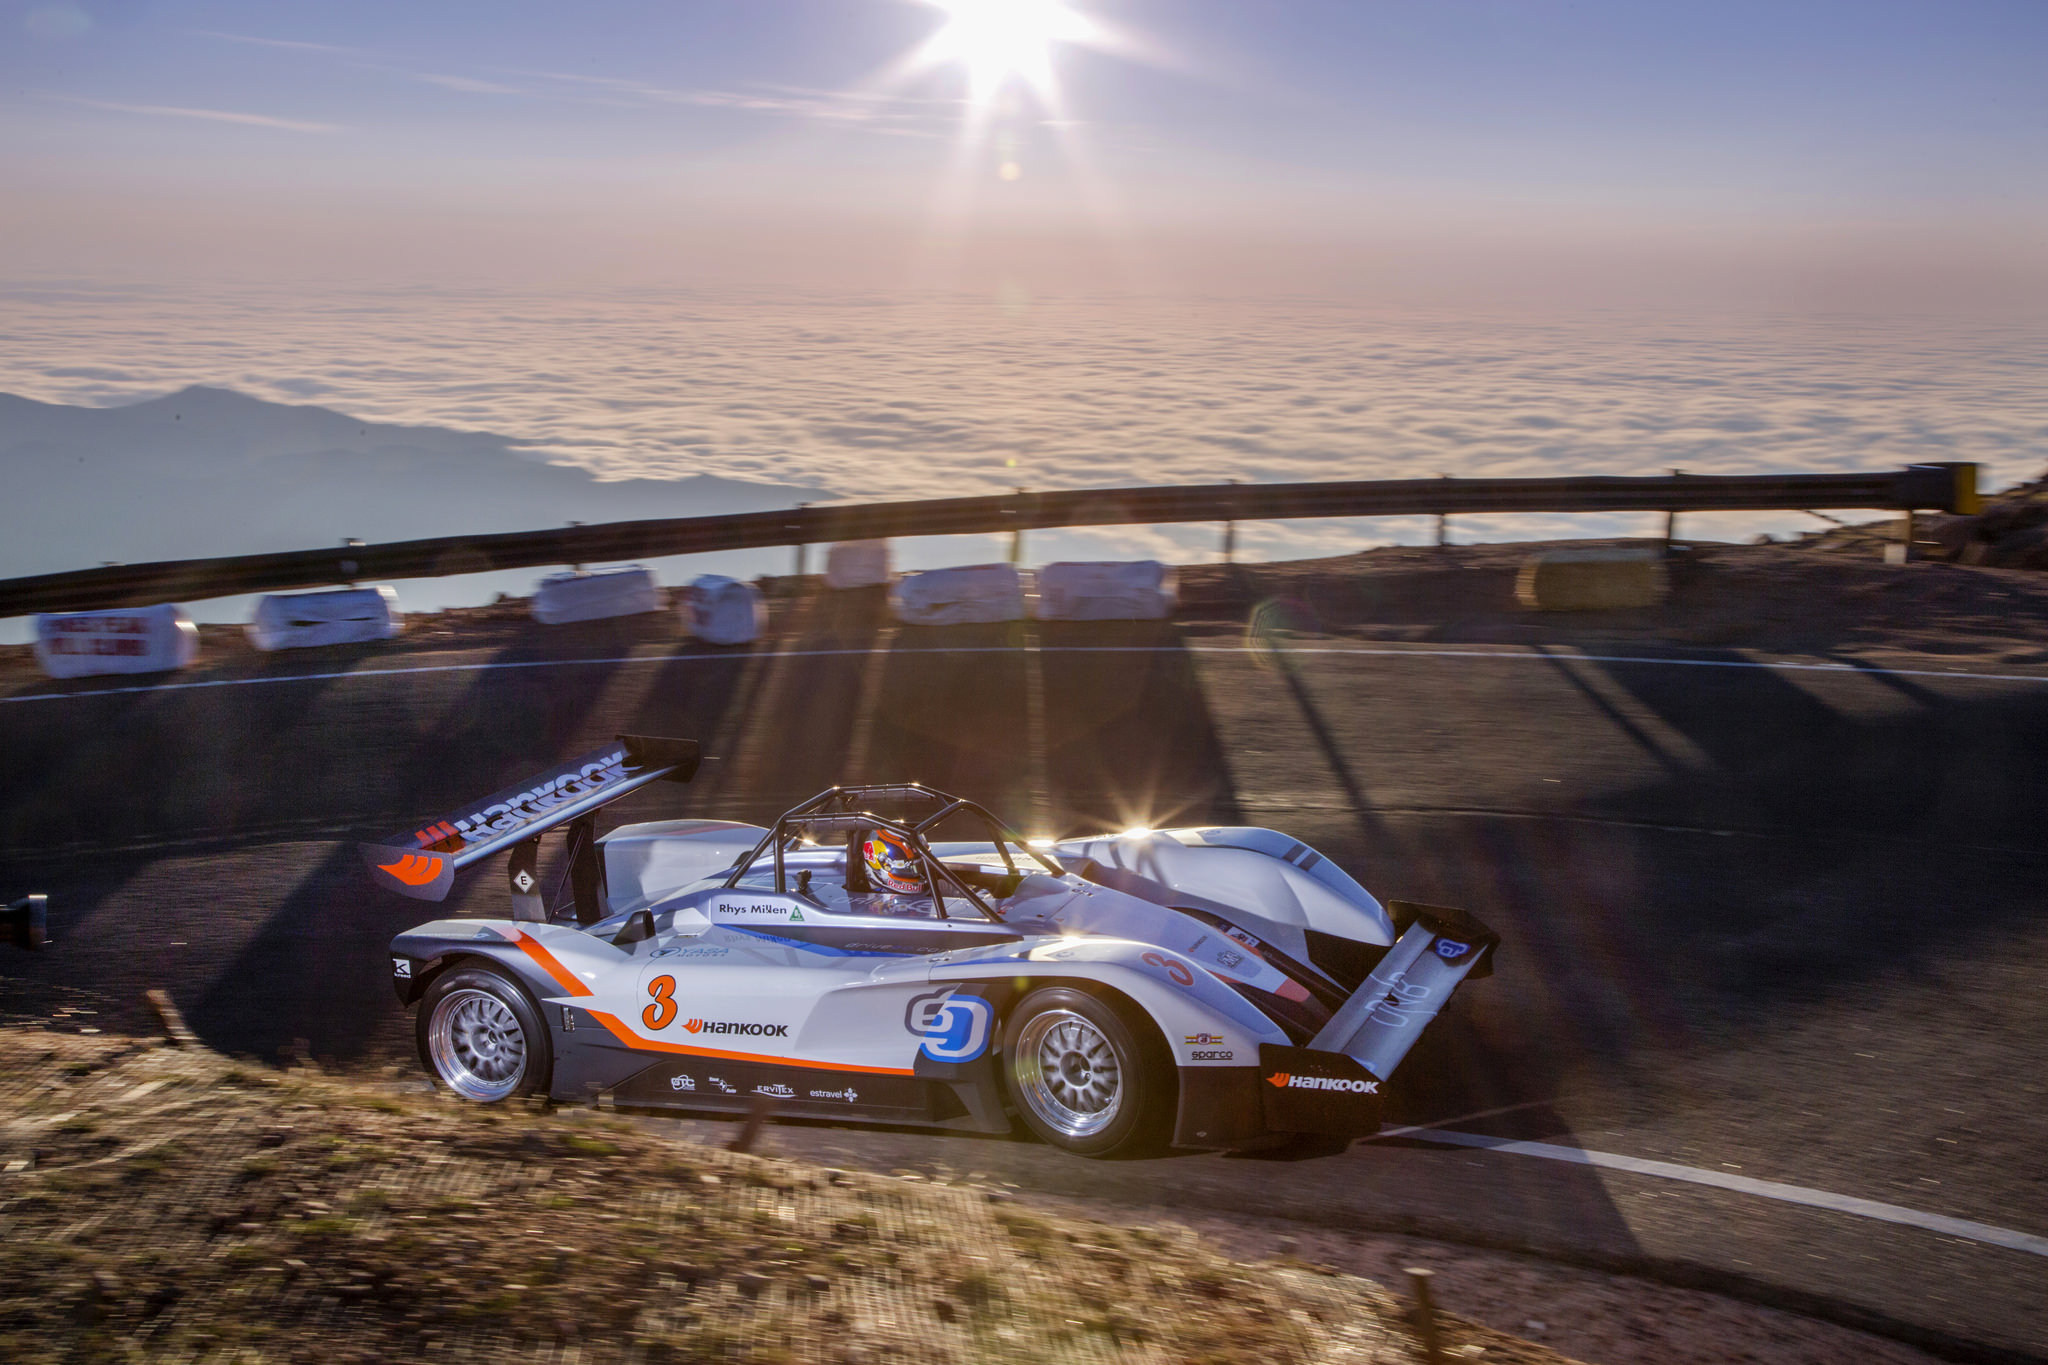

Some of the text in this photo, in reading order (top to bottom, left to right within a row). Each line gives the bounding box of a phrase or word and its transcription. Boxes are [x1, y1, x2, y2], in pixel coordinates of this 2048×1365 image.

[520, 876, 528, 886] E
[888, 880, 905, 891] Red
[719, 904, 747, 915] Rhys
[751, 905, 787, 914] Millen
[1141, 951, 1195, 987] 3
[641, 974, 679, 1031] 3
[1192, 1051, 1233, 1061] sparco
[810, 1090, 843, 1099] estravel
